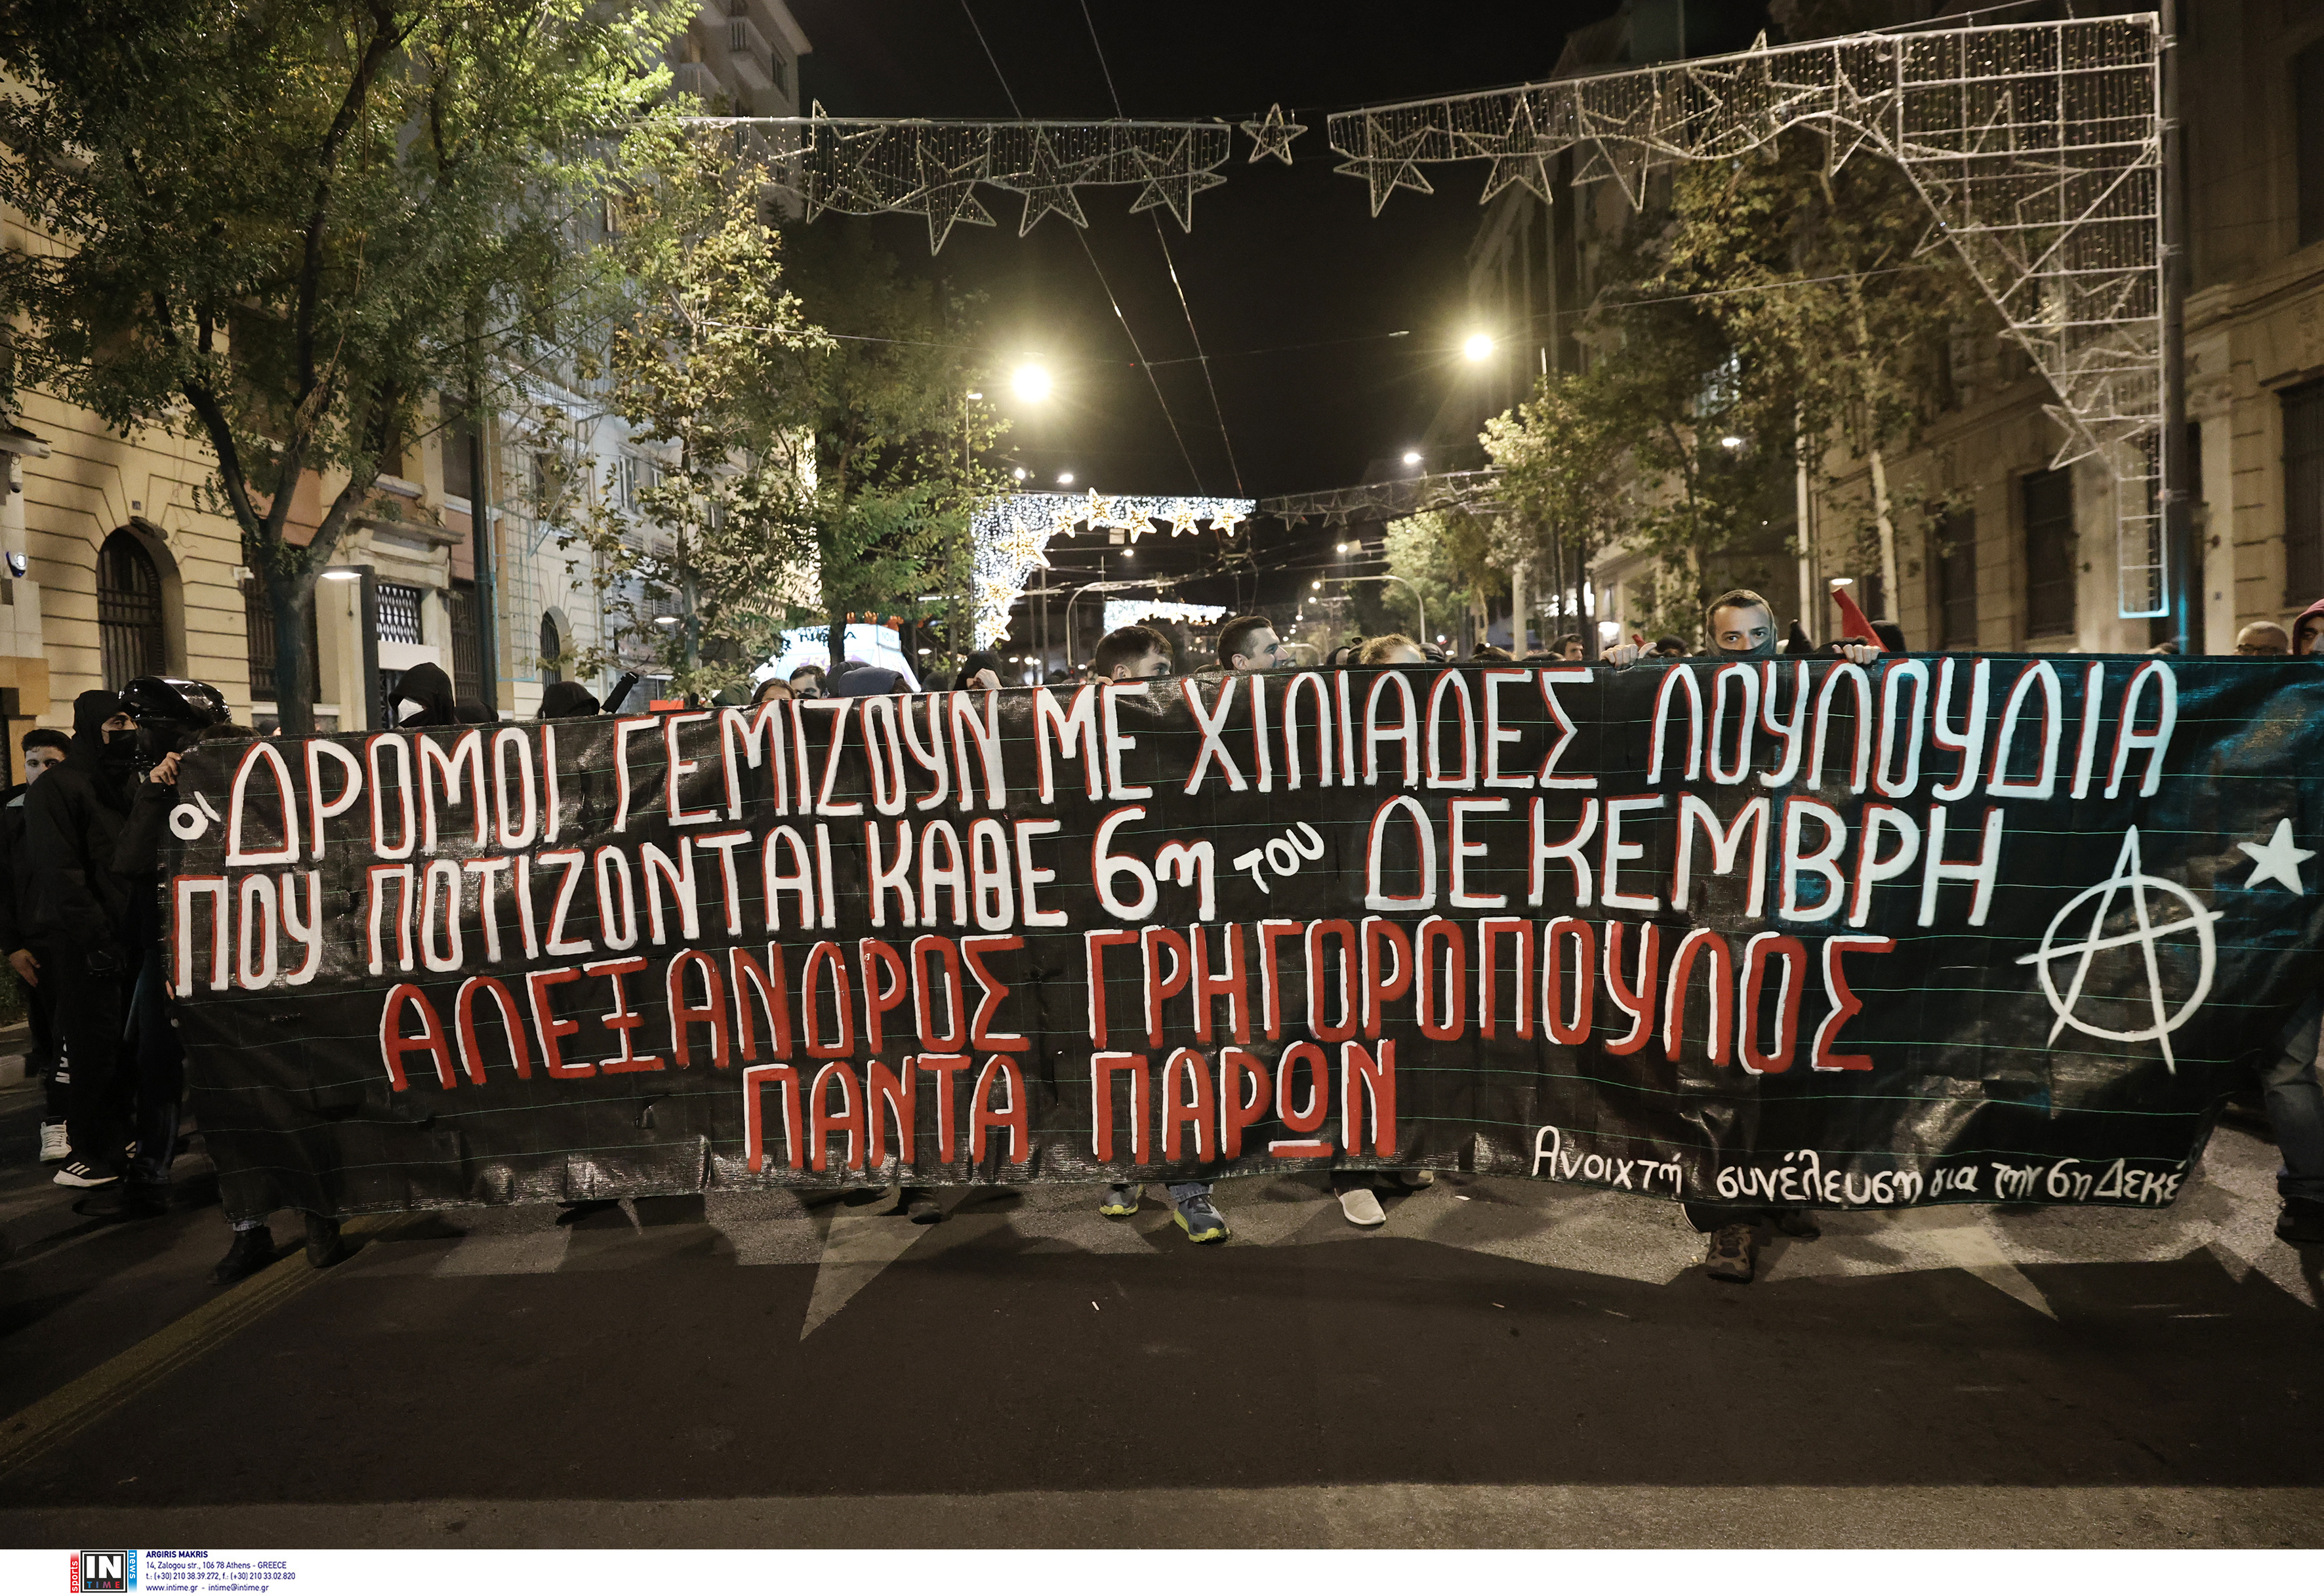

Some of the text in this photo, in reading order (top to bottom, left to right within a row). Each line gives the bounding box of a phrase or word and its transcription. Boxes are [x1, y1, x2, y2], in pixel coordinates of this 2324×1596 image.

[226, 724, 560, 867] ΔΡΟΜΟΙ
[613, 689, 1006, 832] ΓΕΜΙΖΟΥΝ
[1033, 682, 1153, 804] ΜΕ
[1181, 667, 1597, 794] ΧΙΛΙΑΔΕΣ
[1647, 657, 2178, 801] ΛΟΥΛΟΥΔΙΑ
[172, 869, 321, 997] ΠΟΥ
[366, 823, 836, 975] ΠΟΤΙΖΟΝΤΑΙ
[865, 817, 1068, 931] ΚΑΘΕ
[1092, 804, 1215, 921] 6η
[1364, 792, 2004, 928] ΔΕΚΕΜΒΡΗ
[379, 915, 1896, 1091] ΑΛΕΞΑΝΔΡΟΣ ΓΡΗΓΟΡΟΠΟΥΛΟΣ
[744, 1054, 1030, 1174] ΠΑΝΤΑ
[1532, 1126, 1682, 1199] Ανοιχτή
[1717, 1149, 1923, 1204] συνέλευση
[1930, 1165, 1979, 1197] για
